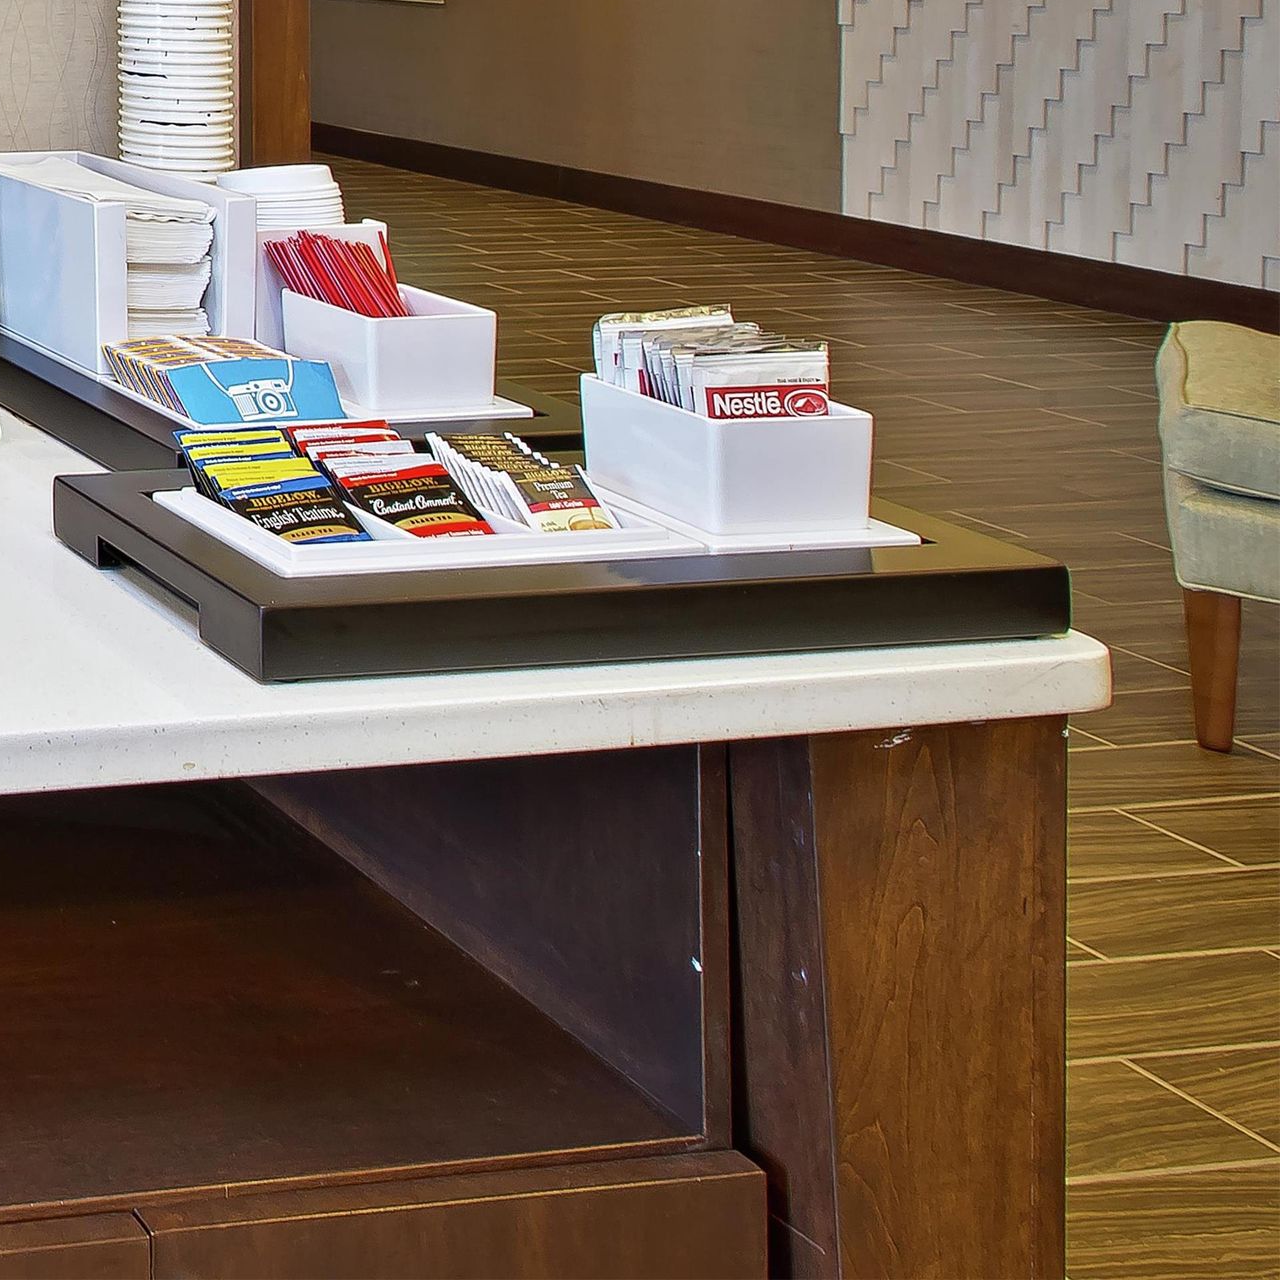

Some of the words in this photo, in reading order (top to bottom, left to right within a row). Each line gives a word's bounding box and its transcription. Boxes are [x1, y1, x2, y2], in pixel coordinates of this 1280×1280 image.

[712, 391, 780, 416] Nestlé
[533, 480, 574, 492] Premium
[550, 490, 568, 499] Tea
